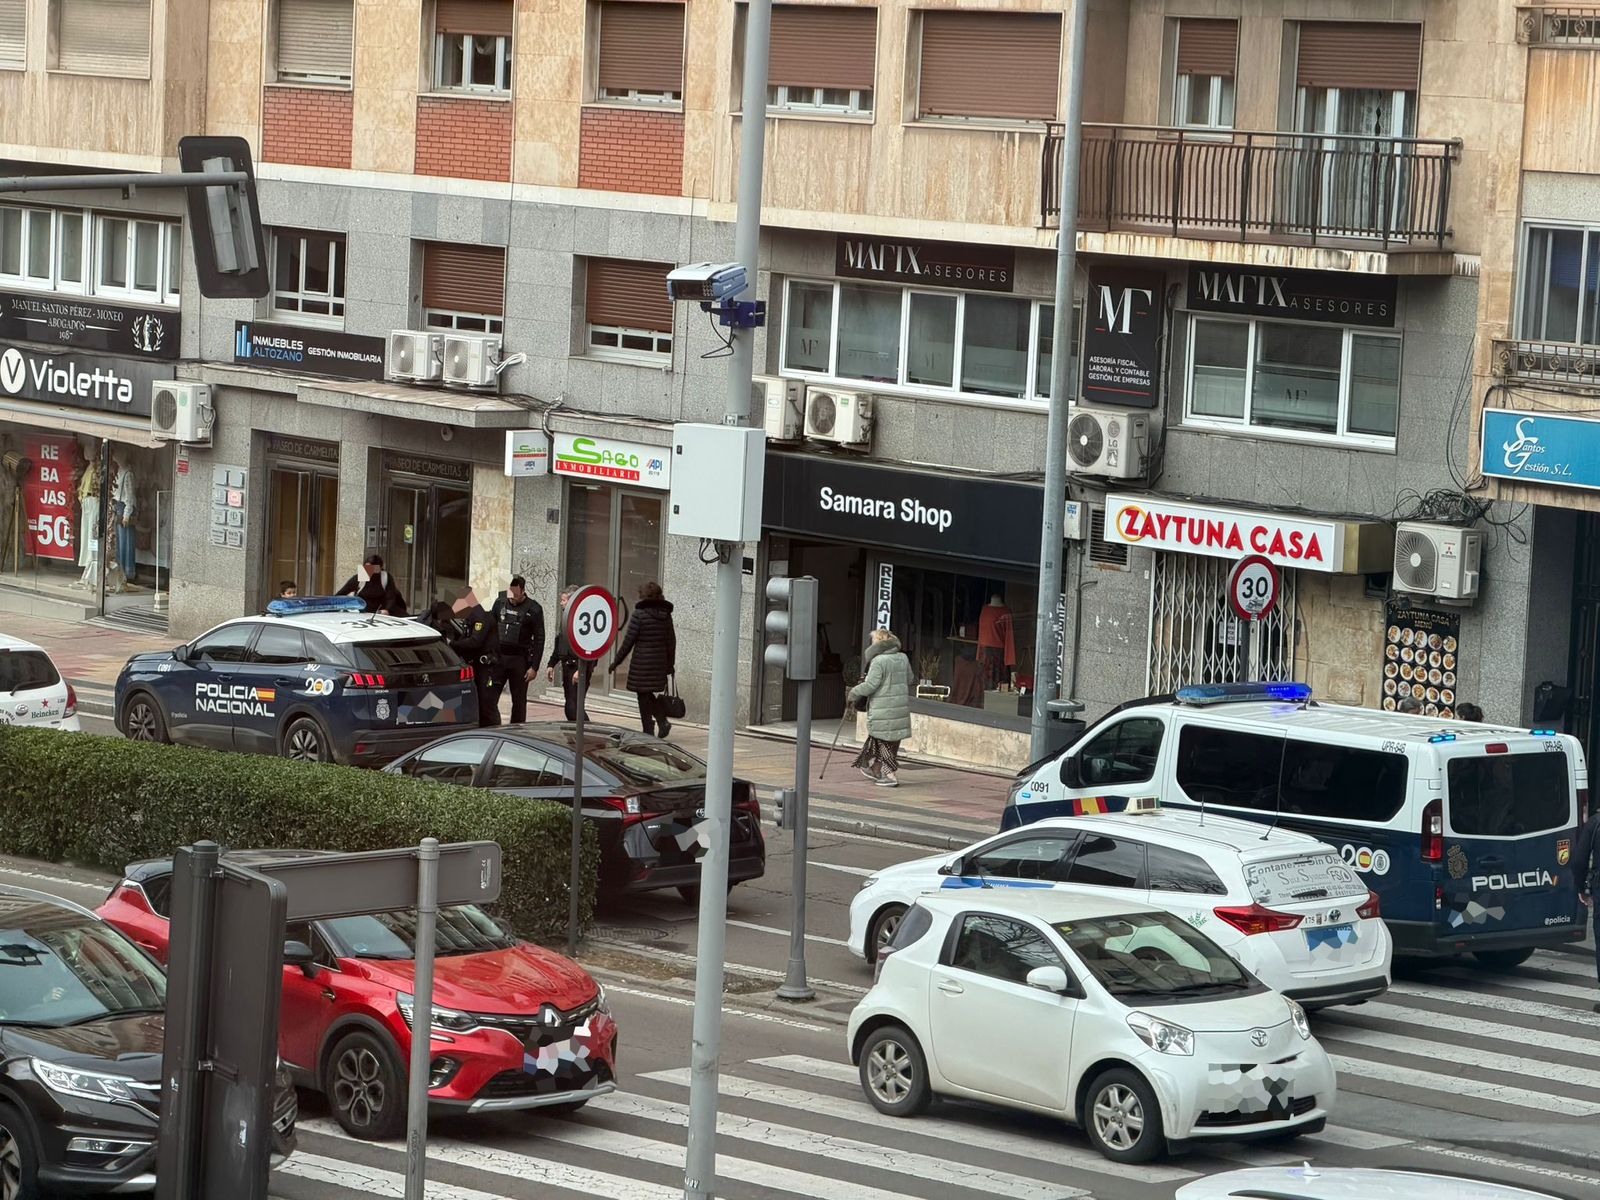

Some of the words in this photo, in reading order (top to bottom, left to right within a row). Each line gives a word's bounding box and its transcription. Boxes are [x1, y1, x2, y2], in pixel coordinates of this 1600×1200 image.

[924, 264, 1007, 283] ASESORES
[12, 299, 41, 314] MANUEL
[42, 303, 69, 316] SANTOS
[97, 310, 124, 322] MONEO
[1290, 297, 1388, 317] ASESORES
[48, 318, 86, 331] ABOGADOS
[253, 335, 304, 351] INMUEBLES
[307, 346, 336, 359] GESTIÓN
[336, 350, 382, 364] INMOBILIARIA
[253, 347, 303, 362] ALTOZANO
[29, 358, 133, 403] Violetta
[1089, 365, 1115, 374] LABORAL
[1120, 368, 1150, 378] CONTABLE
[1113, 375, 1121, 383] DE
[1122, 377, 1151, 386] EMPRESAS
[41, 445, 59, 460] RE
[41, 467, 59, 482] BA
[557, 462, 639, 480] INMOBILIARIA
[40, 490, 66, 506] JAS
[820, 486, 895, 520] Samara
[901, 498, 953, 533] Shop
[1125, 509, 1244, 551] ZAYTUNA
[1250, 526, 1324, 562] CASA
[1243, 577, 1268, 599] 30
[579, 610, 607, 636] 30
[196, 698, 276, 718] NACIONAL
[1472, 868, 1553, 892] POLICÍA
